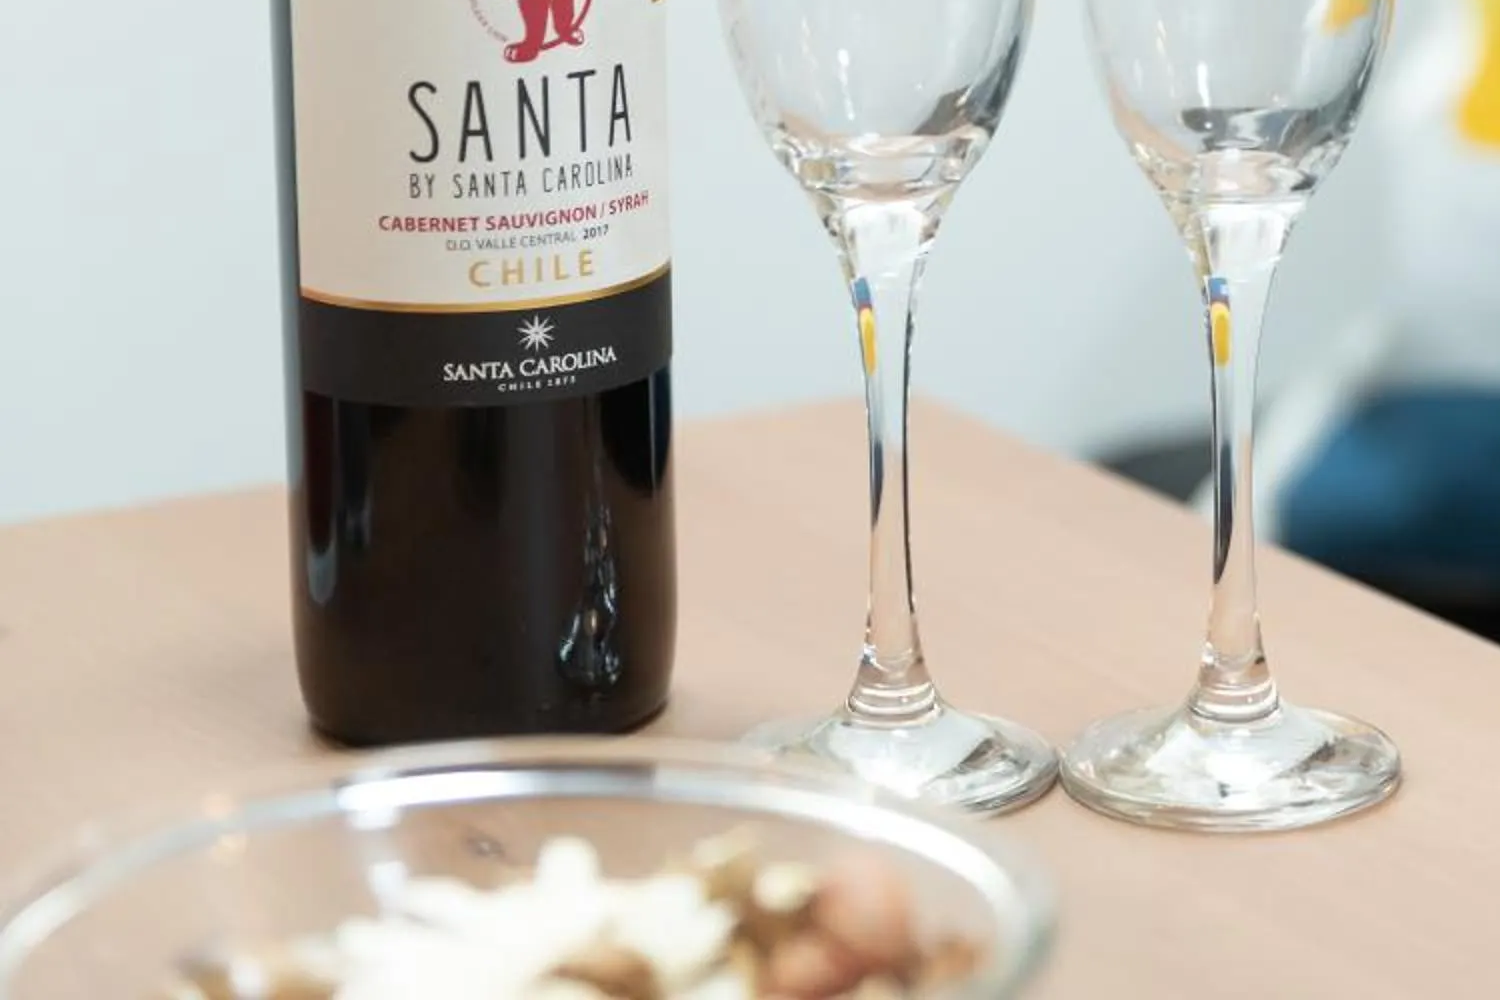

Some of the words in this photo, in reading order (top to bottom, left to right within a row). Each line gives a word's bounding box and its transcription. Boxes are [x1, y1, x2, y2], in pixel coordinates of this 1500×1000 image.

[408, 63, 632, 163] SANTA
[409, 173, 435, 199] BY
[453, 170, 527, 199] SANTA
[543, 153, 633, 193] CAROLINA
[378, 215, 478, 233] CABERNET
[485, 204, 596, 232] SAUVIGNON
[608, 190, 649, 215] SYRAH
[476, 236, 516, 250] VALLE
[519, 231, 576, 248] CENTRAL
[582, 224, 609, 240] 2017
[468, 249, 595, 287] CHILE
[443, 361, 515, 381] SANTA
[519, 345, 617, 377] CAROLINA
[497, 379, 541, 392] CHILE
